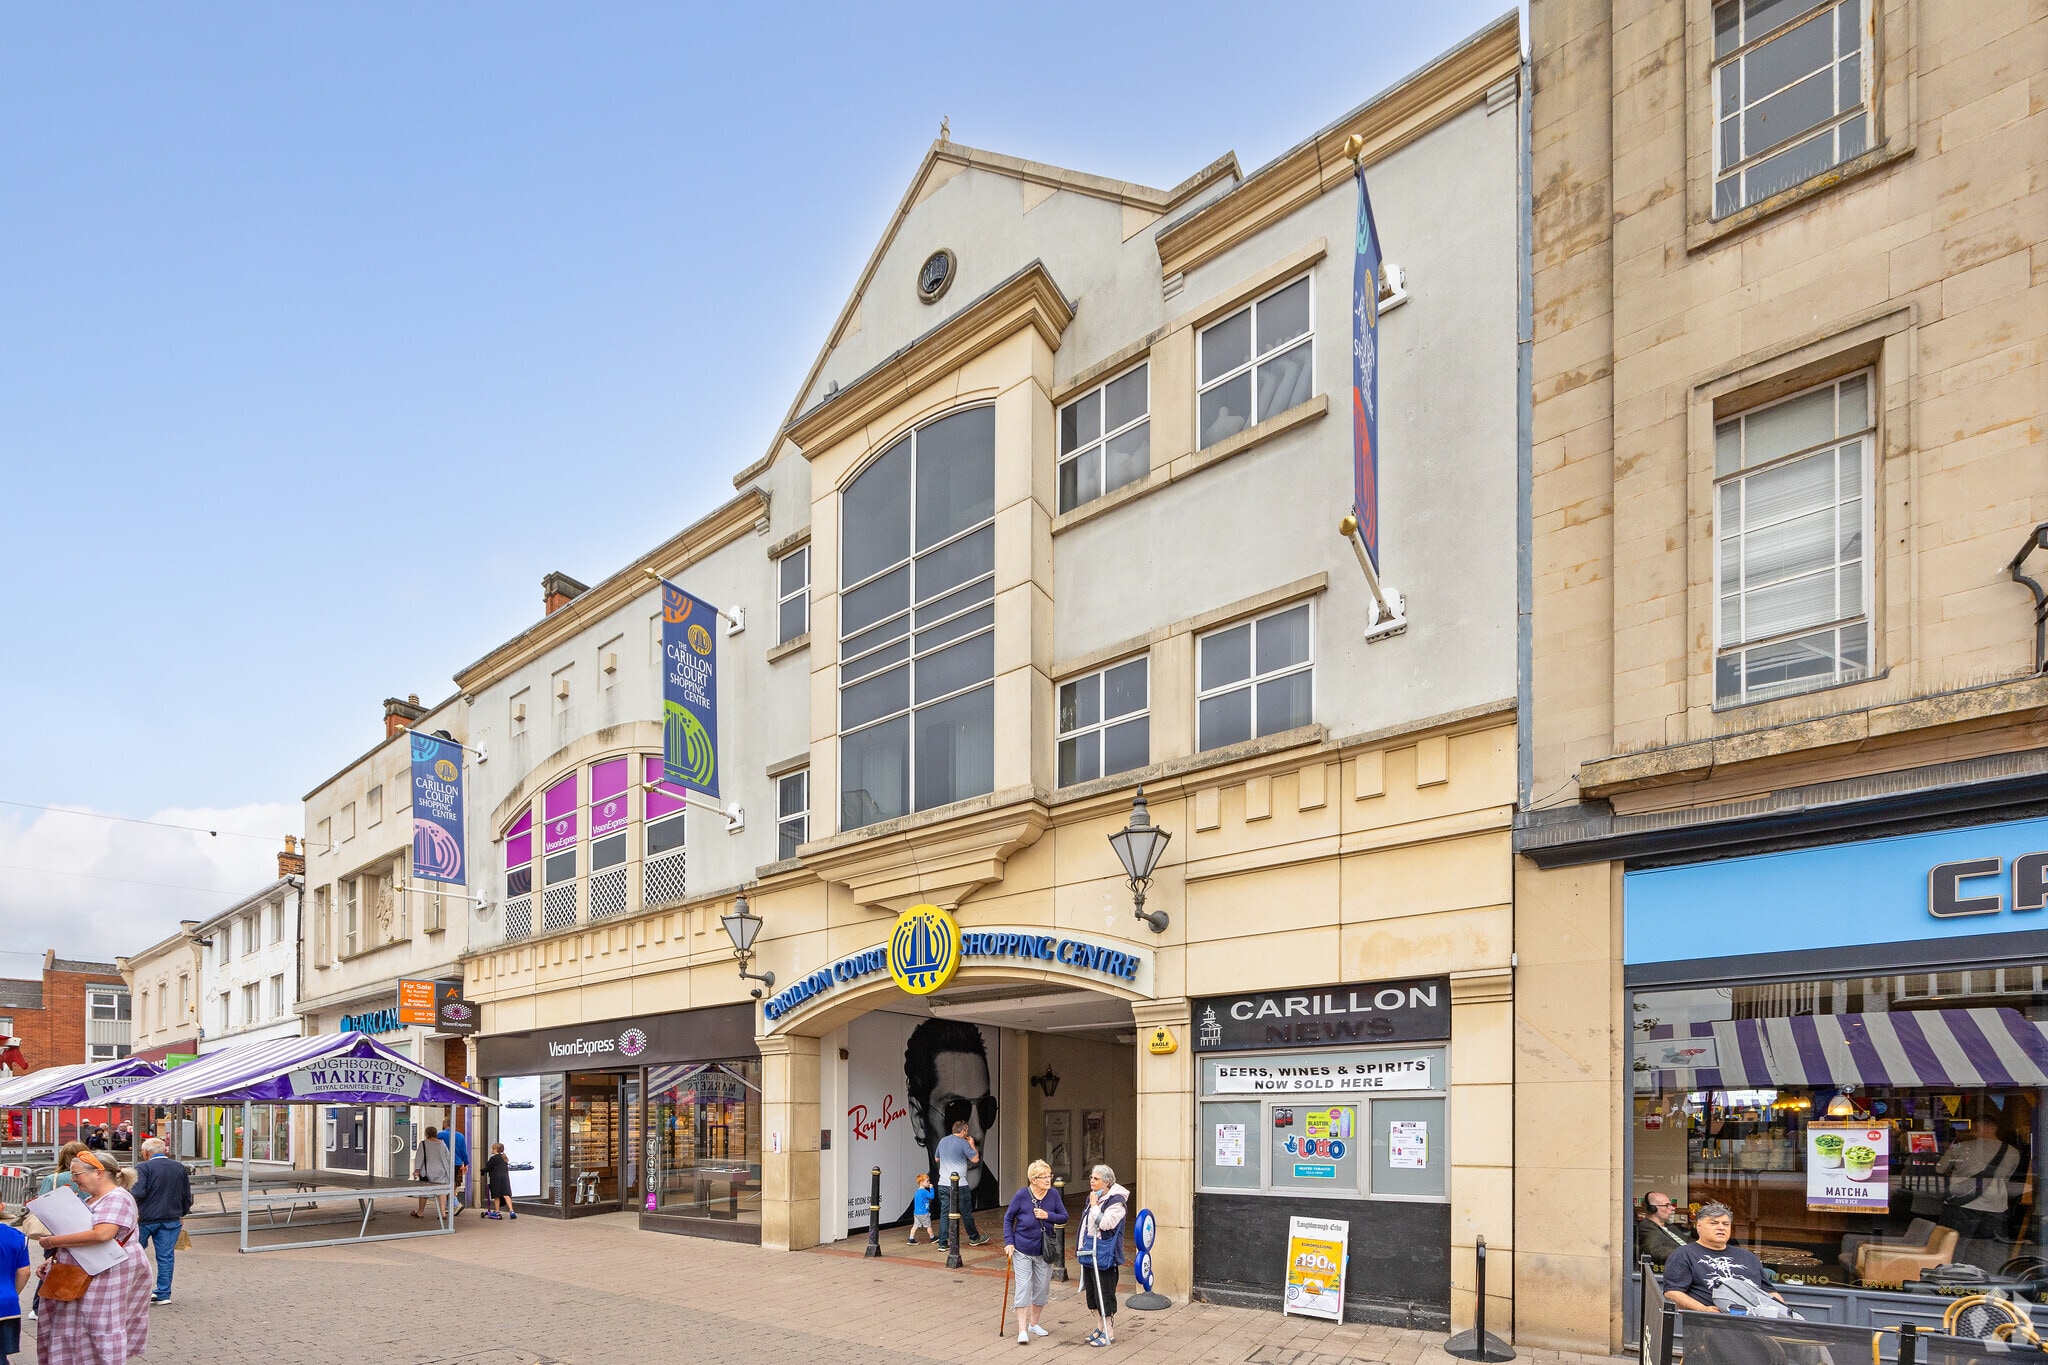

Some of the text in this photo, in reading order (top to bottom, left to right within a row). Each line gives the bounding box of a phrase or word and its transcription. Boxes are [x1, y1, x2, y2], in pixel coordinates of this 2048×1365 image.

[678, 641, 687, 651] THE
[667, 644, 712, 676] CARILLON
[677, 662, 708, 687] COURT
[670, 672, 704, 696] SHOPPING
[684, 689, 710, 709] CENTRE
[416, 777, 459, 796] CARILLON
[419, 798, 451, 811] SHOPPING
[425, 790, 454, 804] COURT
[432, 809, 457, 821] CENTRE
[593, 817, 628, 834] VisionExpress
[960, 932, 1140, 981] SHOPPING CENTRE
[764, 948, 887, 1020] CARILLON COURT
[1230, 986, 1437, 1021] CARILLON
[352, 1008, 404, 1034] BARCLAY
[1266, 1017, 1396, 1044] NEWS
[549, 1038, 614, 1057] VisionExpress
[1220, 1061, 1426, 1078] BEERS, WINES & SPIRITS
[310, 1070, 405, 1088] MARKETS
[1255, 1077, 1383, 1090] NOW SOLD HERE
[1826, 1186, 1868, 1197] MATCHA
[855, 1197, 866, 1205] ICON
[1297, 1220, 1342, 1231] Loughborough Echo
[1862, 1280, 1904, 1290] LATTE
[1939, 1286, 2001, 1295] MOCHA
